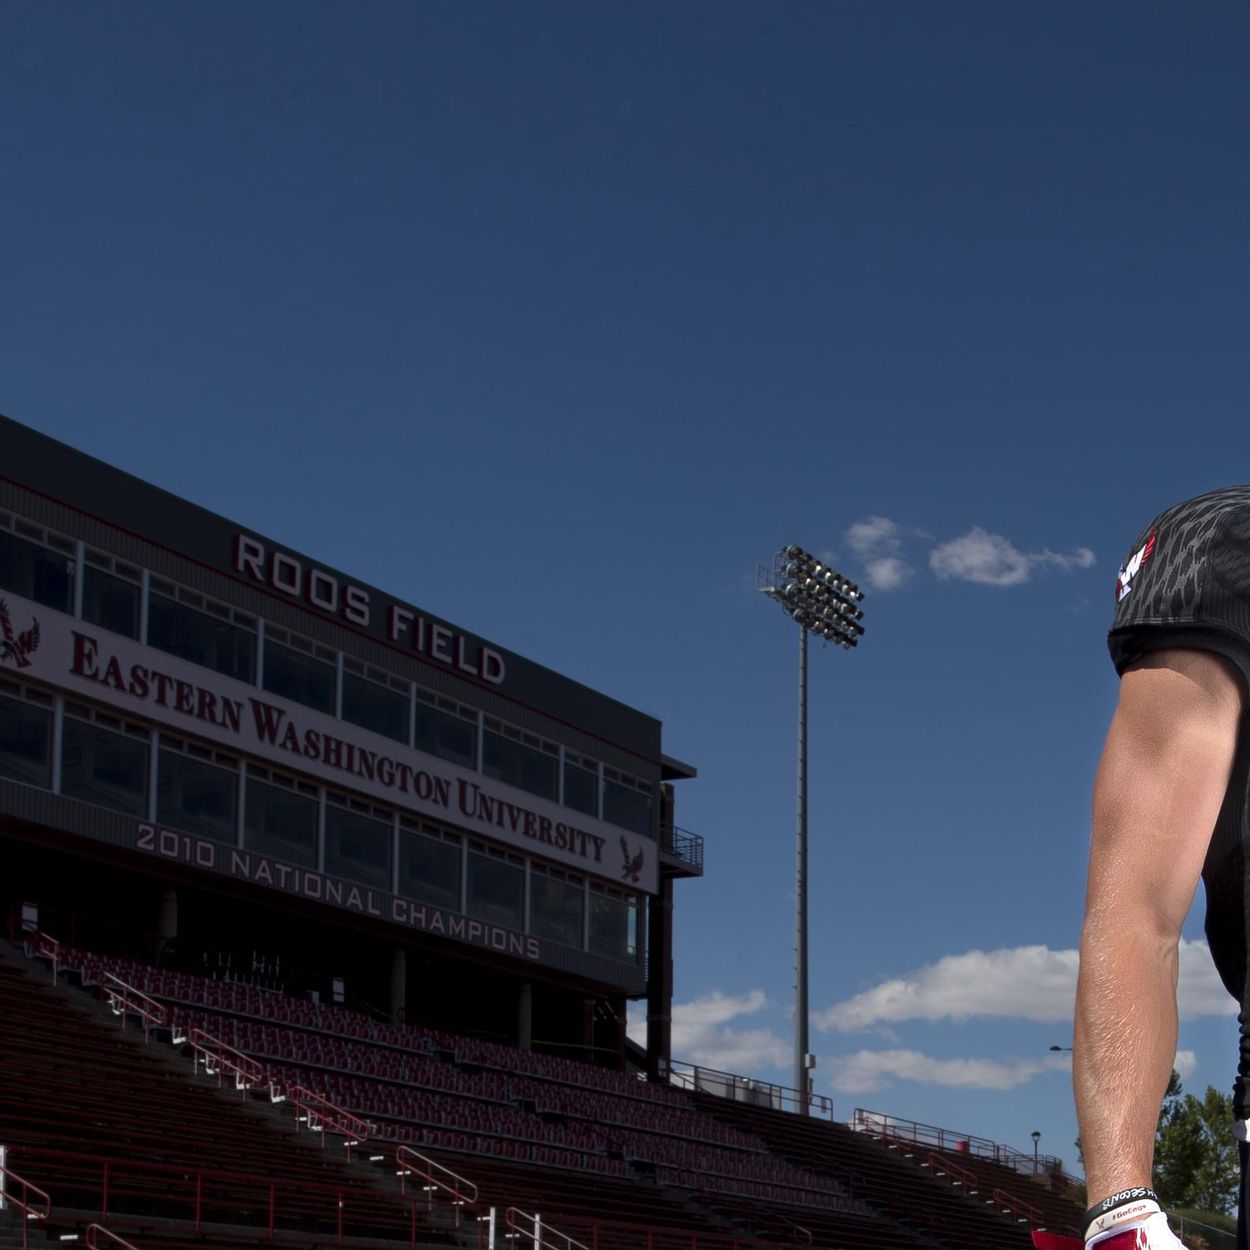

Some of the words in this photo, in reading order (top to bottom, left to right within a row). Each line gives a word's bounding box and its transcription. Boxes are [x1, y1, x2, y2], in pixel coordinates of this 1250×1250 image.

[234, 532, 370, 627] ROOS
[389, 605, 505, 685] FIELD
[70, 630, 243, 733] EASTERN
[249, 698, 451, 808] WASHINGTON
[457, 778, 606, 863] UNIVERSITY
[136, 823, 214, 868] 2010
[231, 850, 381, 916] NATIONAL
[393, 898, 540, 960] CHAMPIONS
